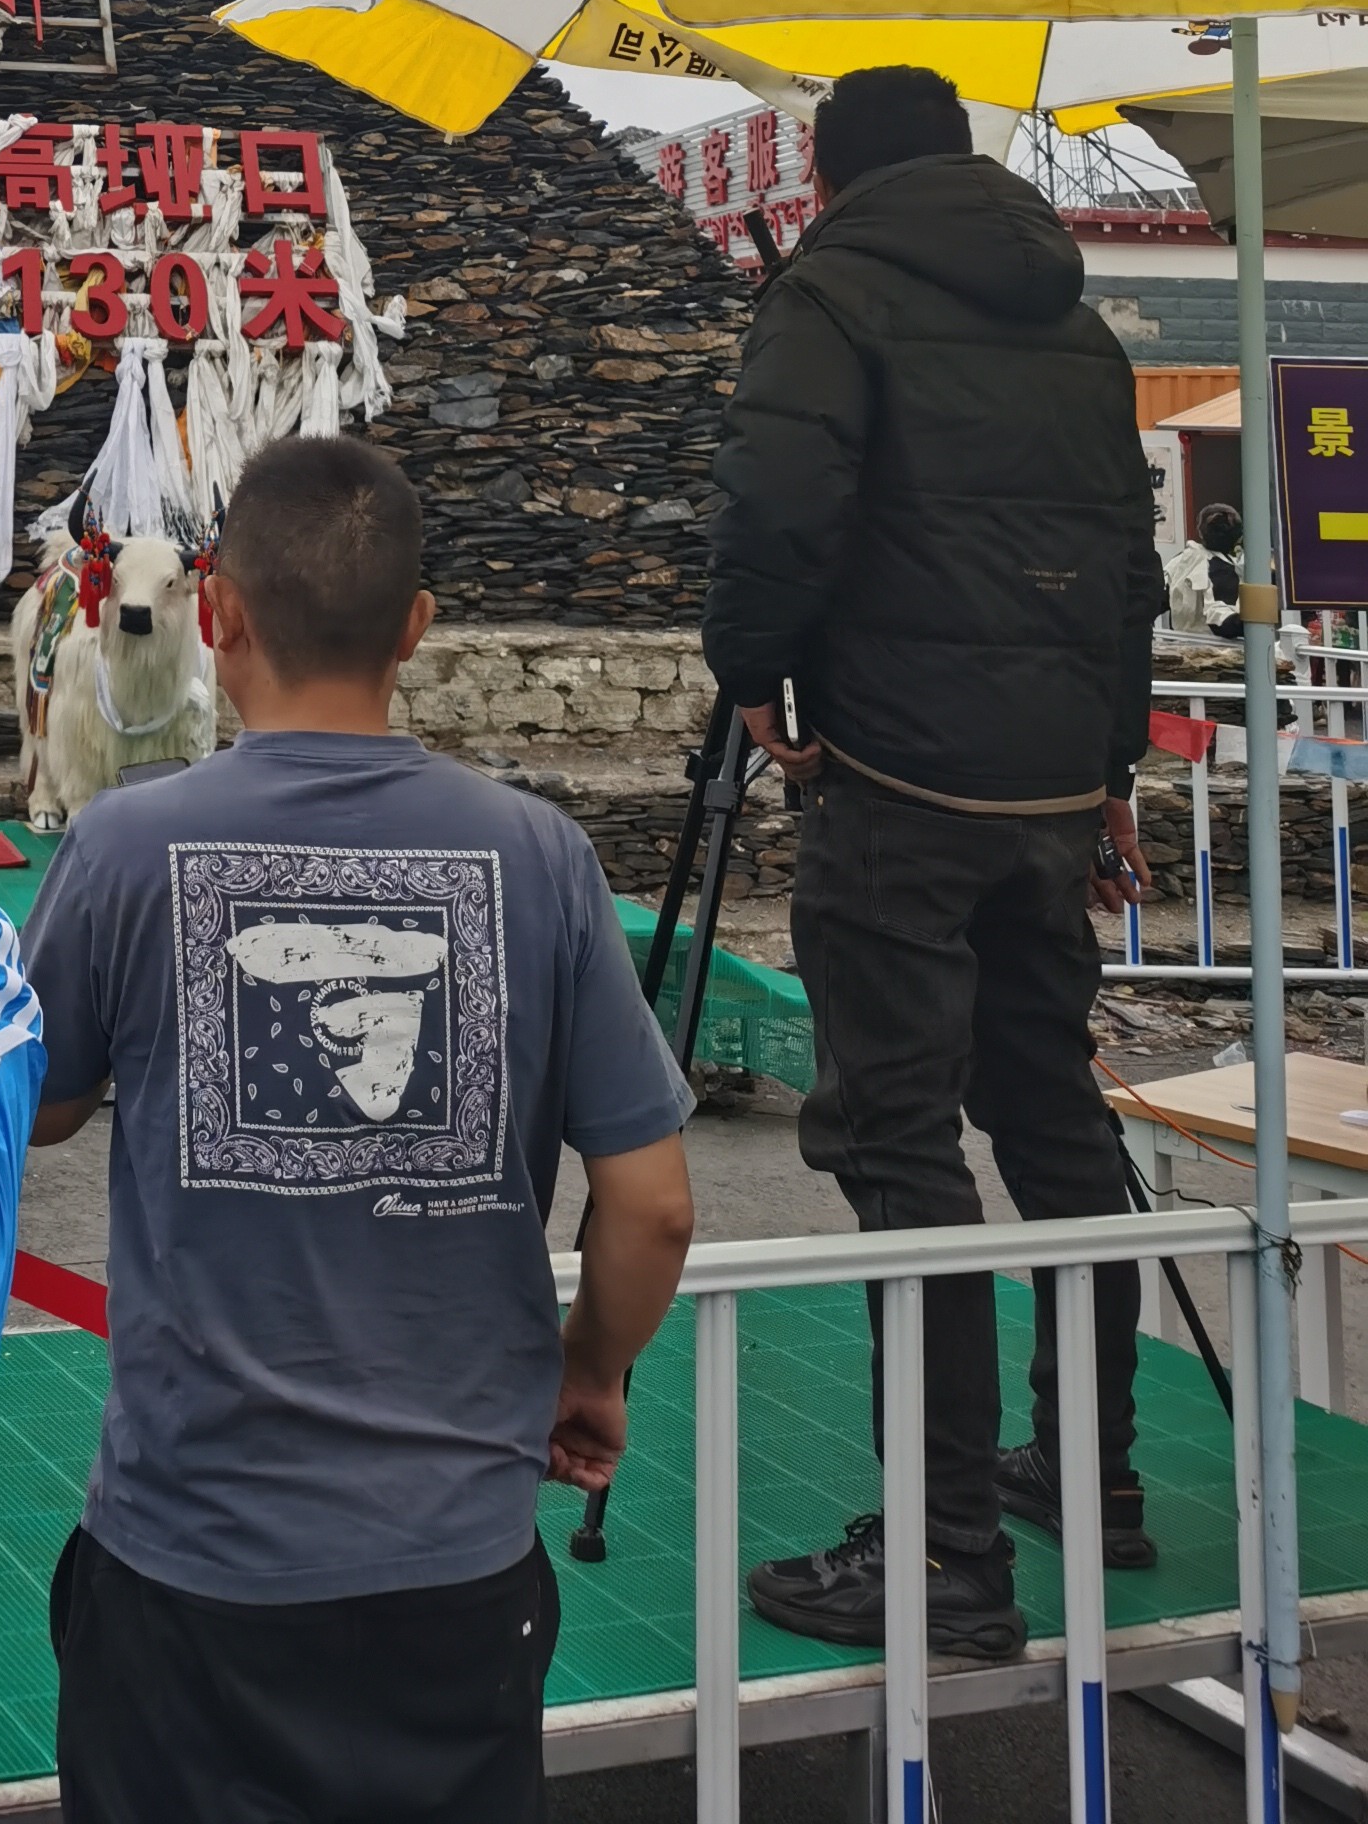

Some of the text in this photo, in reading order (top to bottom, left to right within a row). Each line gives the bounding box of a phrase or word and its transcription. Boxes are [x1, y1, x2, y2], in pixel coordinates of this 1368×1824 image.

[1307, 407, 1354, 457] 景
[428, 1200, 449, 1208] HAVE
[450, 1199, 457, 1207] A
[427, 1209, 444, 1217] ONE
